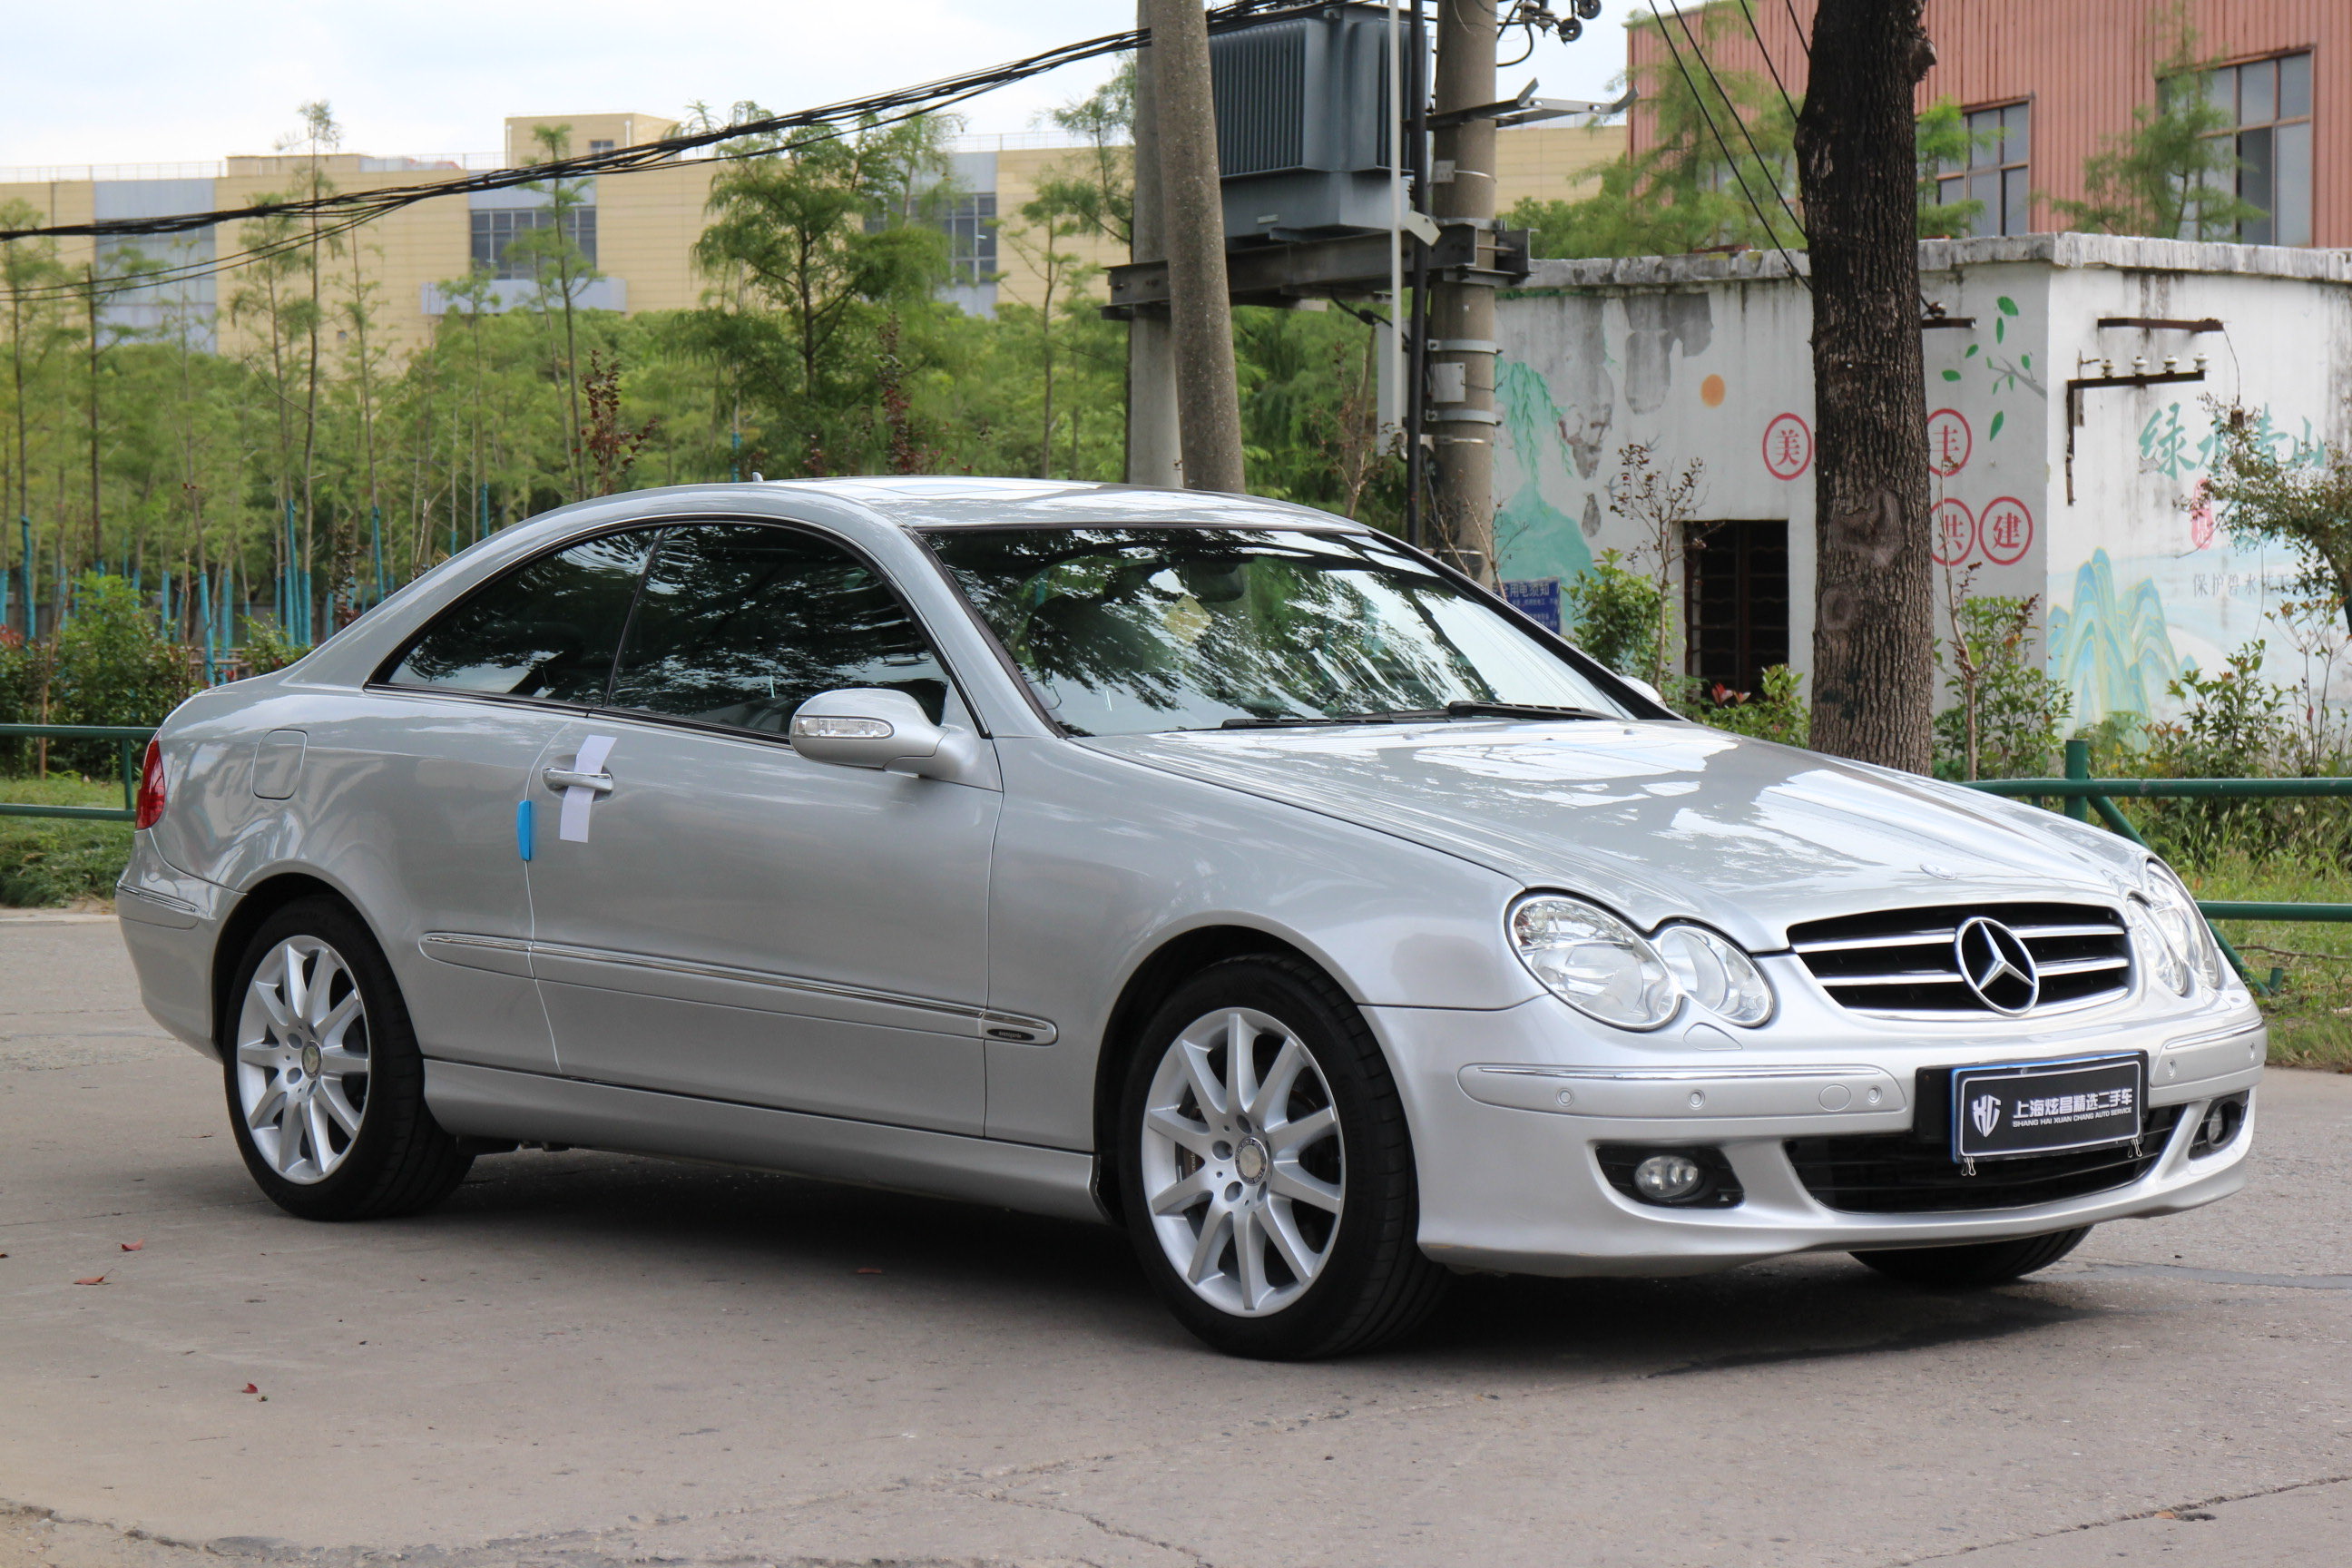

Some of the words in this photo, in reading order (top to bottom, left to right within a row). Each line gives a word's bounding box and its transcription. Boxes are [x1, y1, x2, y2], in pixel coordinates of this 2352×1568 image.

[1776, 429, 1801, 467] 美
[2013, 1088, 2133, 1119] 上海炫昌精选二手车
[2013, 1119, 2039, 1128] SHANG
[2040, 1117, 2053, 1125] HAI
[2053, 1115, 2073, 1124] XUAN
[2073, 1112, 2094, 1122] CHANG
[2095, 1110, 2111, 1118] AUTO
[2111, 1106, 2132, 1116] SERVICE
